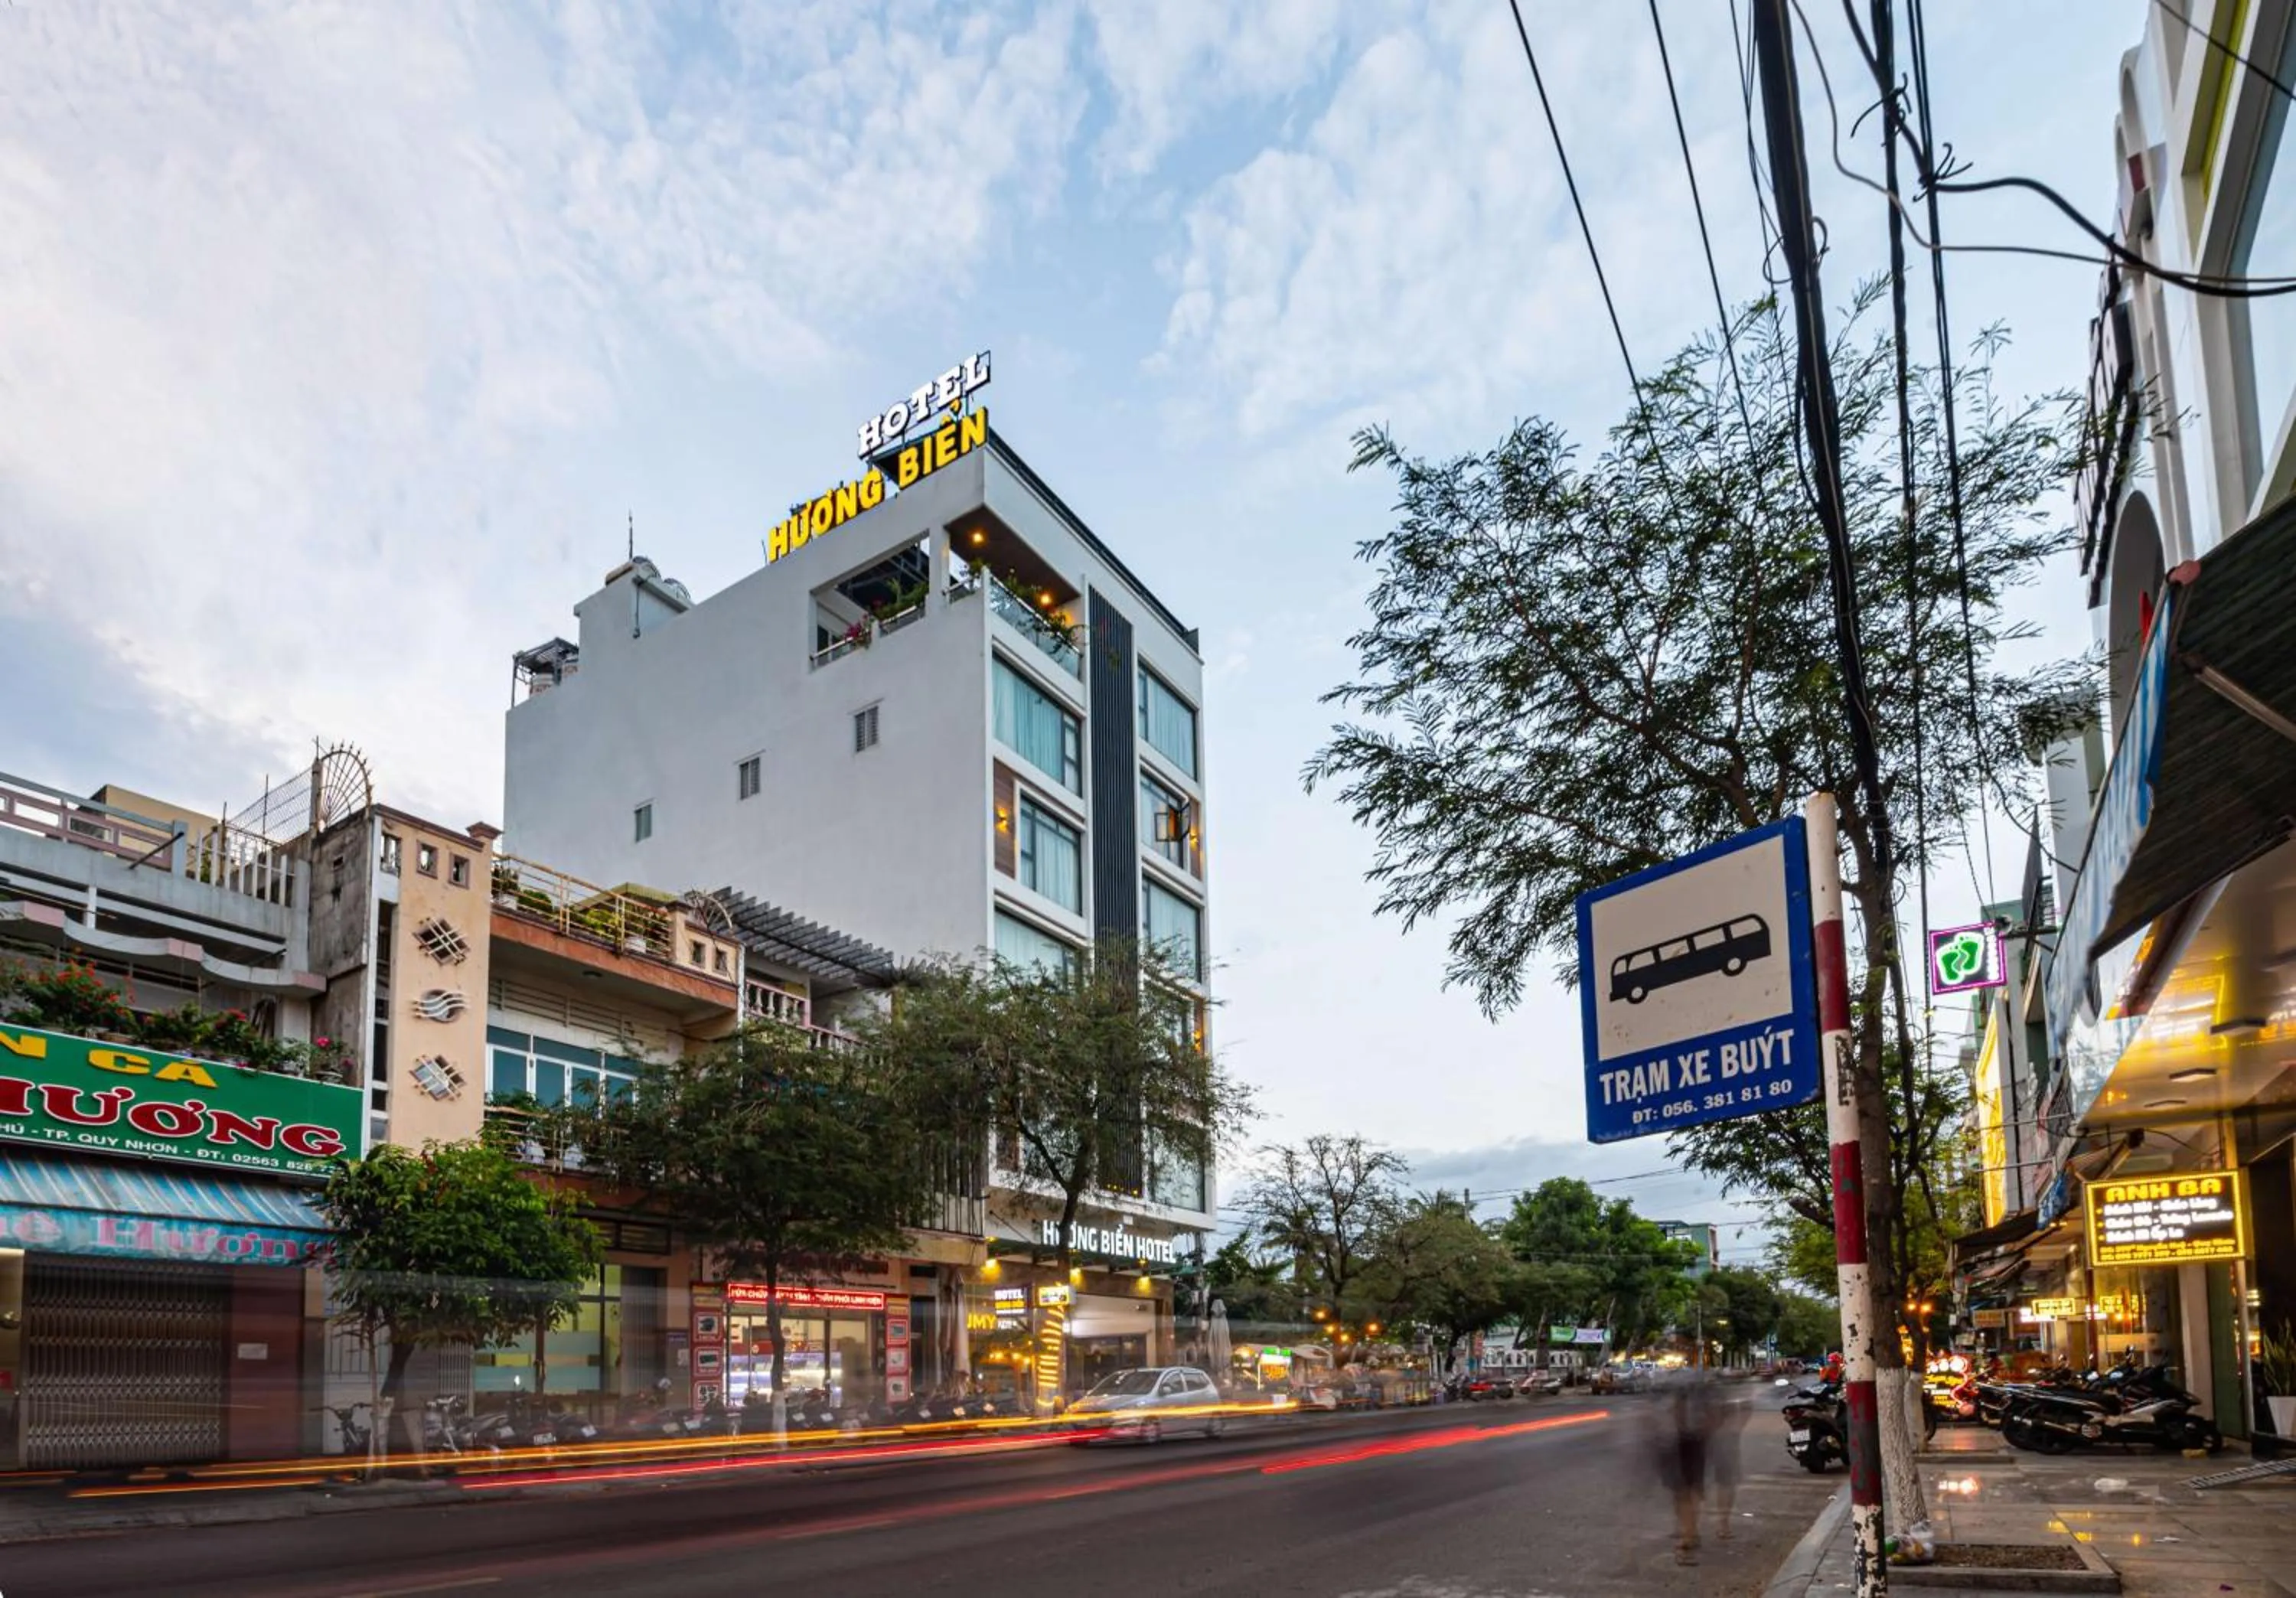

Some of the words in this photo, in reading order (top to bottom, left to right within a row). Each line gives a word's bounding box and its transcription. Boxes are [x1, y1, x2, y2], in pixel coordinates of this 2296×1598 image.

[858, 354, 988, 458] HOTEL
[768, 468, 883, 563] HƯƠNG
[1600, 1059, 1670, 1104] TRẠM
[1678, 1049, 1711, 1088] XE
[1720, 1026, 1794, 1078] BUÝT
[1704, 1091, 1734, 1109] 381
[1741, 1086, 1762, 1101] 81
[1769, 1079, 1792, 1096] 80
[43, 1127, 71, 1141] TP.
[78, 1134, 119, 1146] QUY
[125, 1140, 178, 1154] NHƠN
[233, 1153, 279, 1167] 02563
[2106, 1183, 2170, 1202] ANH
[2177, 1179, 2222, 1196] BA
[1137, 1236, 1176, 1264] HOTEL
